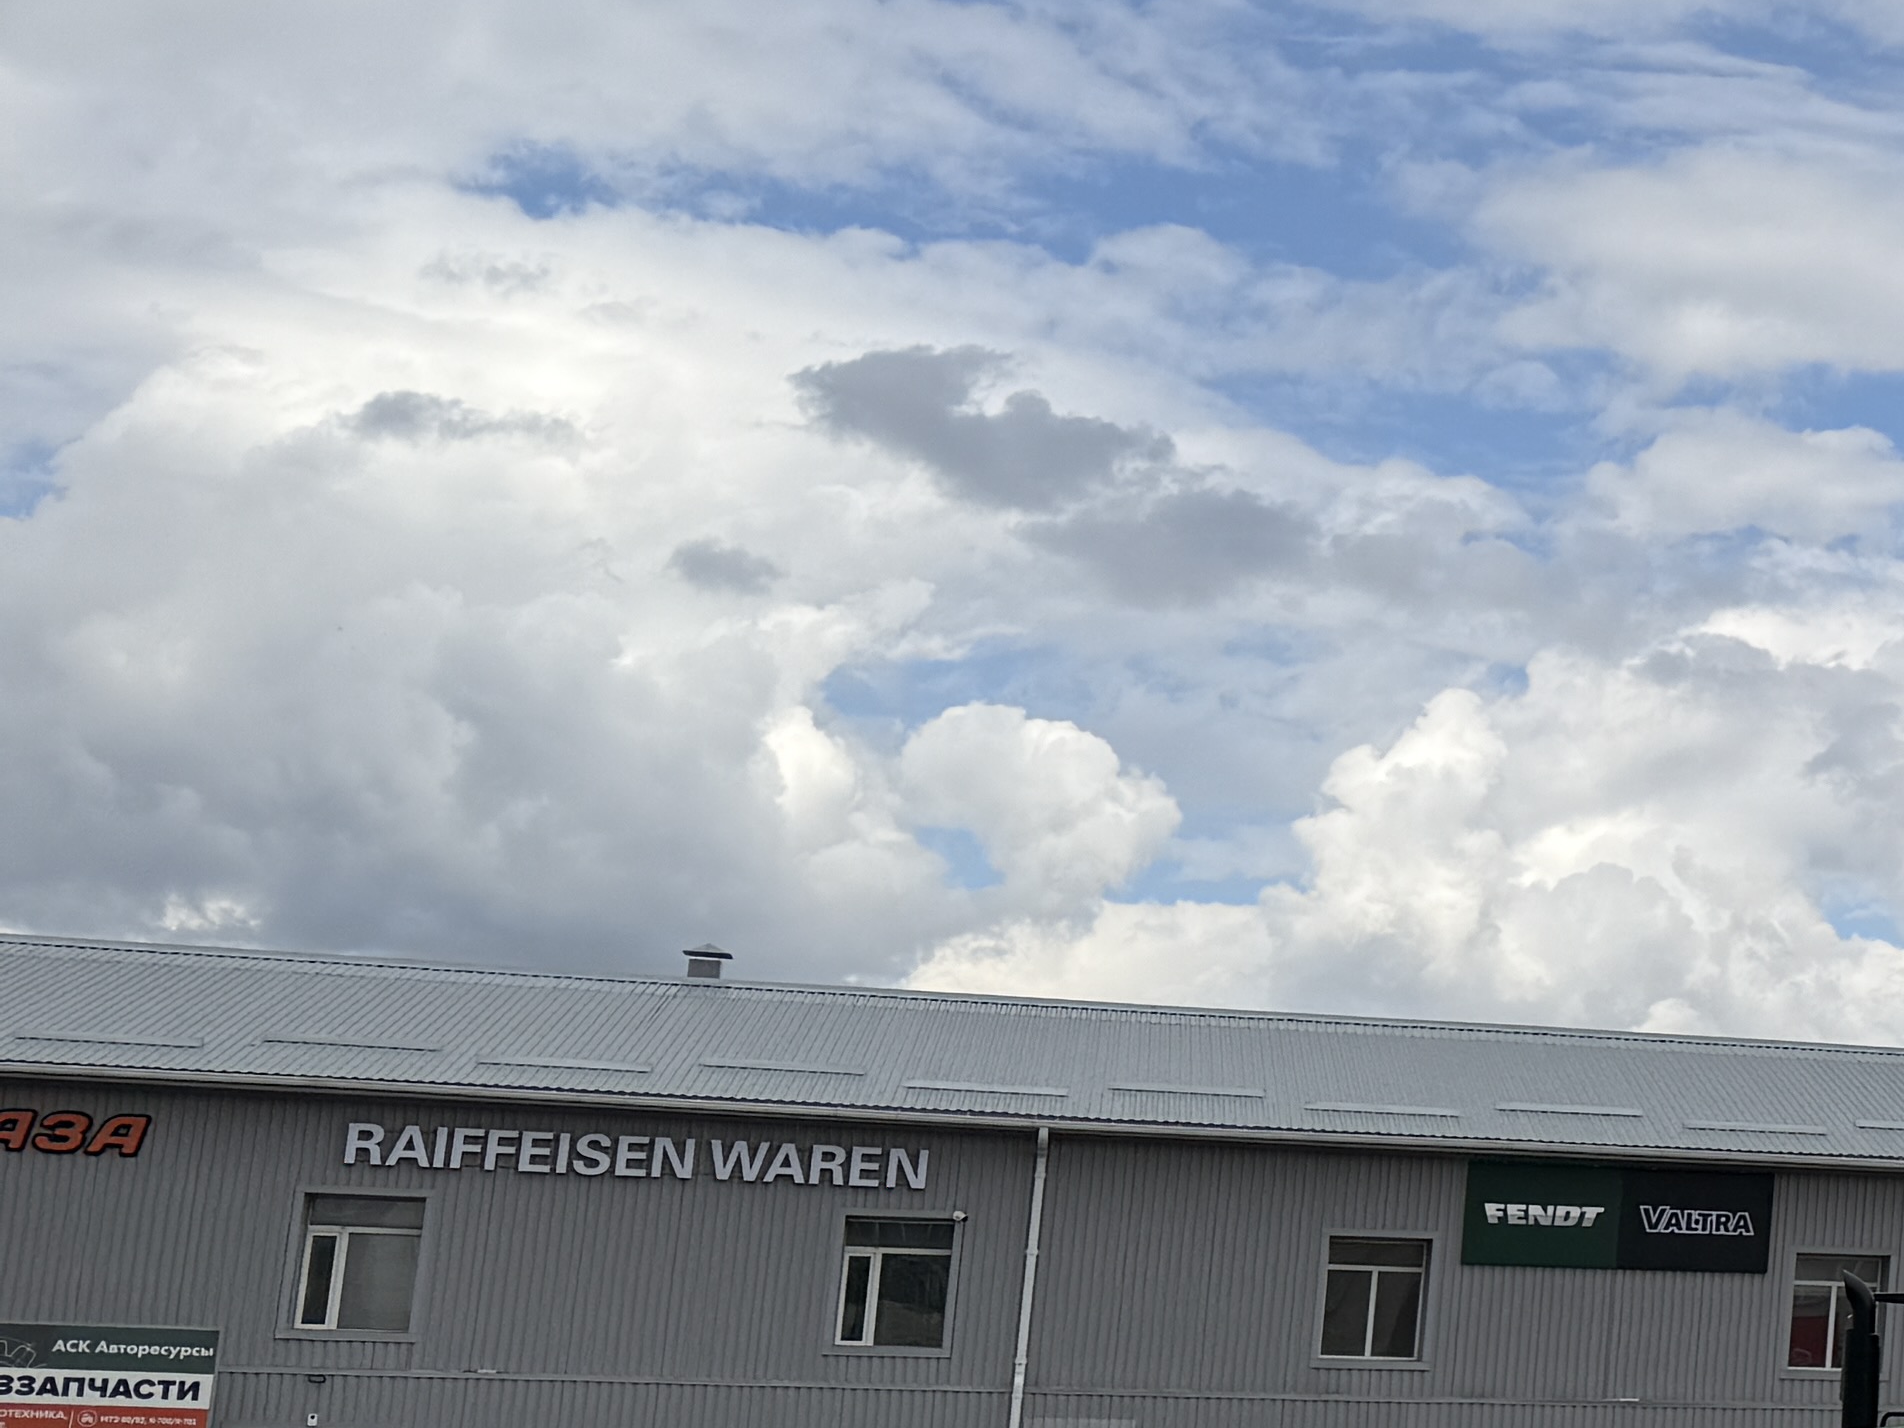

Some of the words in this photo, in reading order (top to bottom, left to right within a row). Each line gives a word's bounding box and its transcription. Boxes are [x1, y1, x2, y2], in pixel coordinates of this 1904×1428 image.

[343, 1122, 695, 1180] RAIFFEISEN
[711, 1139, 930, 1191] WAREN
[1484, 1202, 1605, 1228] FENDT
[1640, 1204, 1755, 1237] VALTRA
[52, 1339, 91, 1353] АСК
[95, 1340, 214, 1360] Авторесурсы
